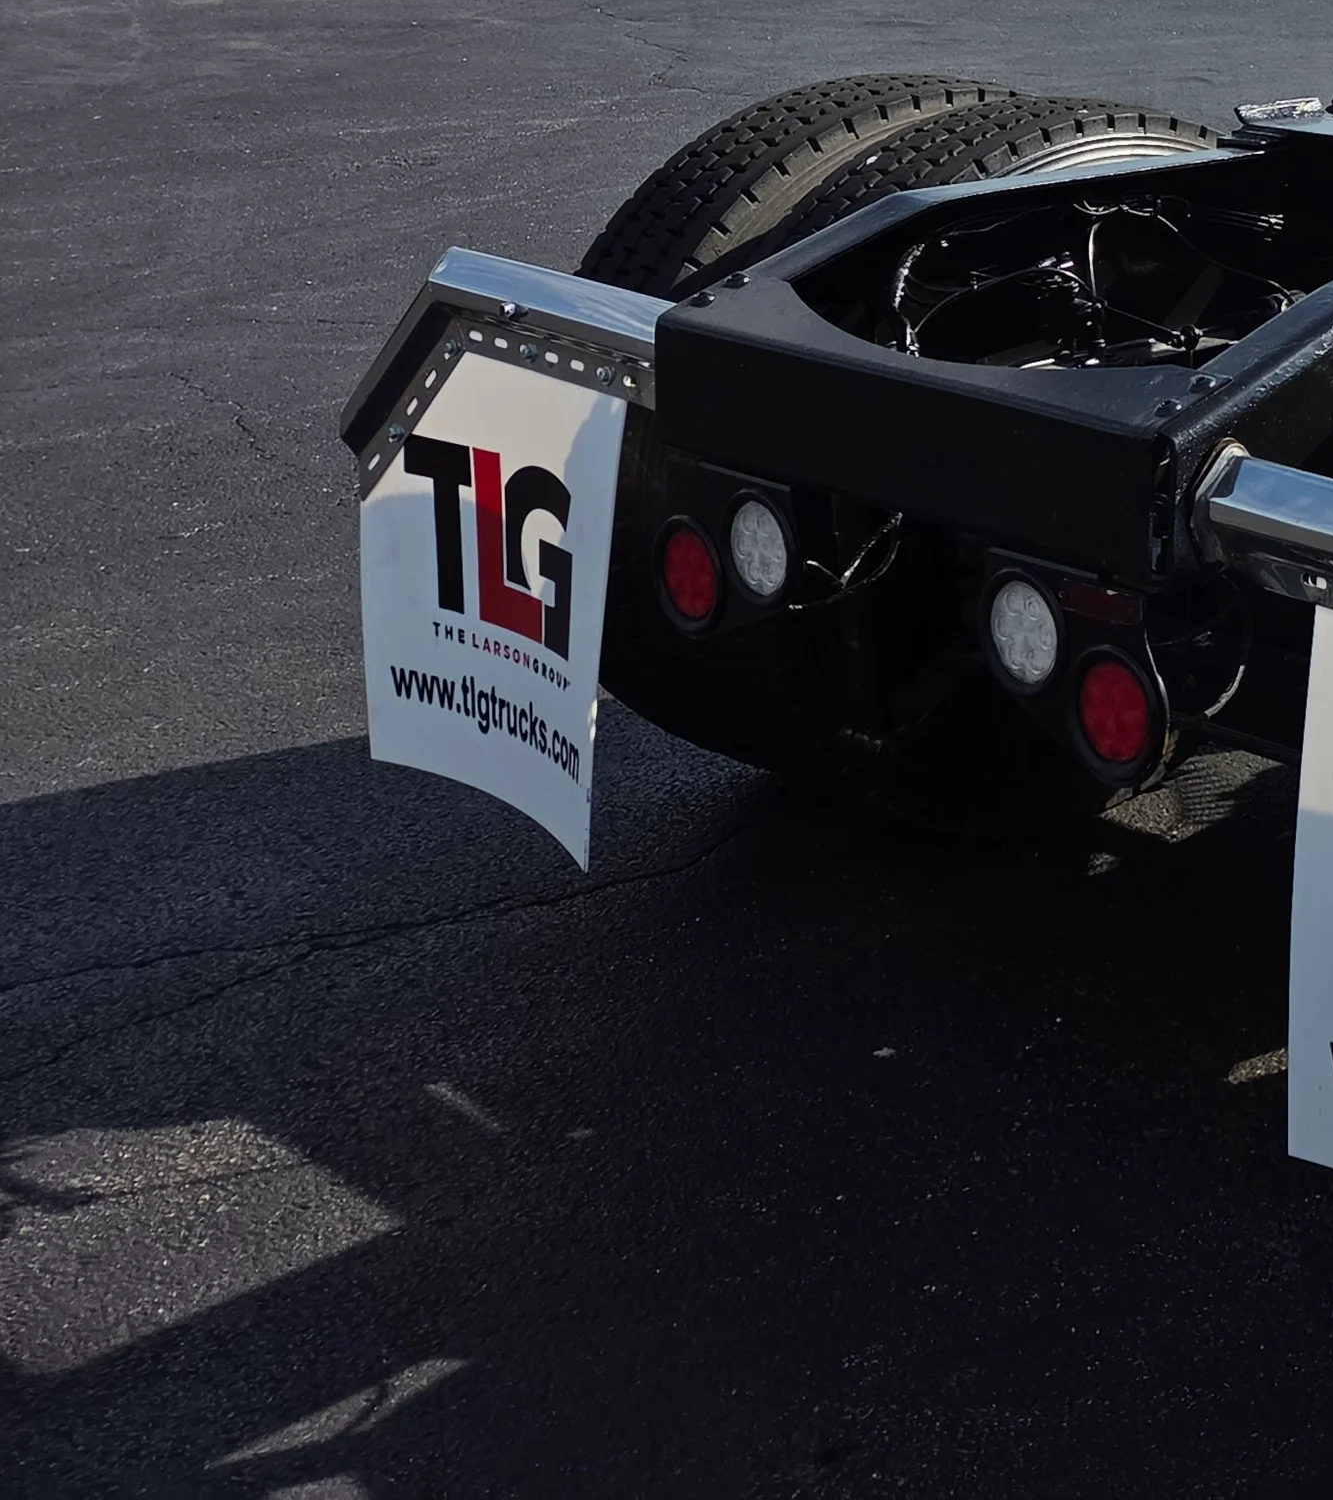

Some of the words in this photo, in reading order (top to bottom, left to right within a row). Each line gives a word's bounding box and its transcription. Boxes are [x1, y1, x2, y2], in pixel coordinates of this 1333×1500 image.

[403, 433, 573, 661] TLG
[432, 621, 466, 645] THE
[390, 665, 580, 784] www.tlgtrucks.com
